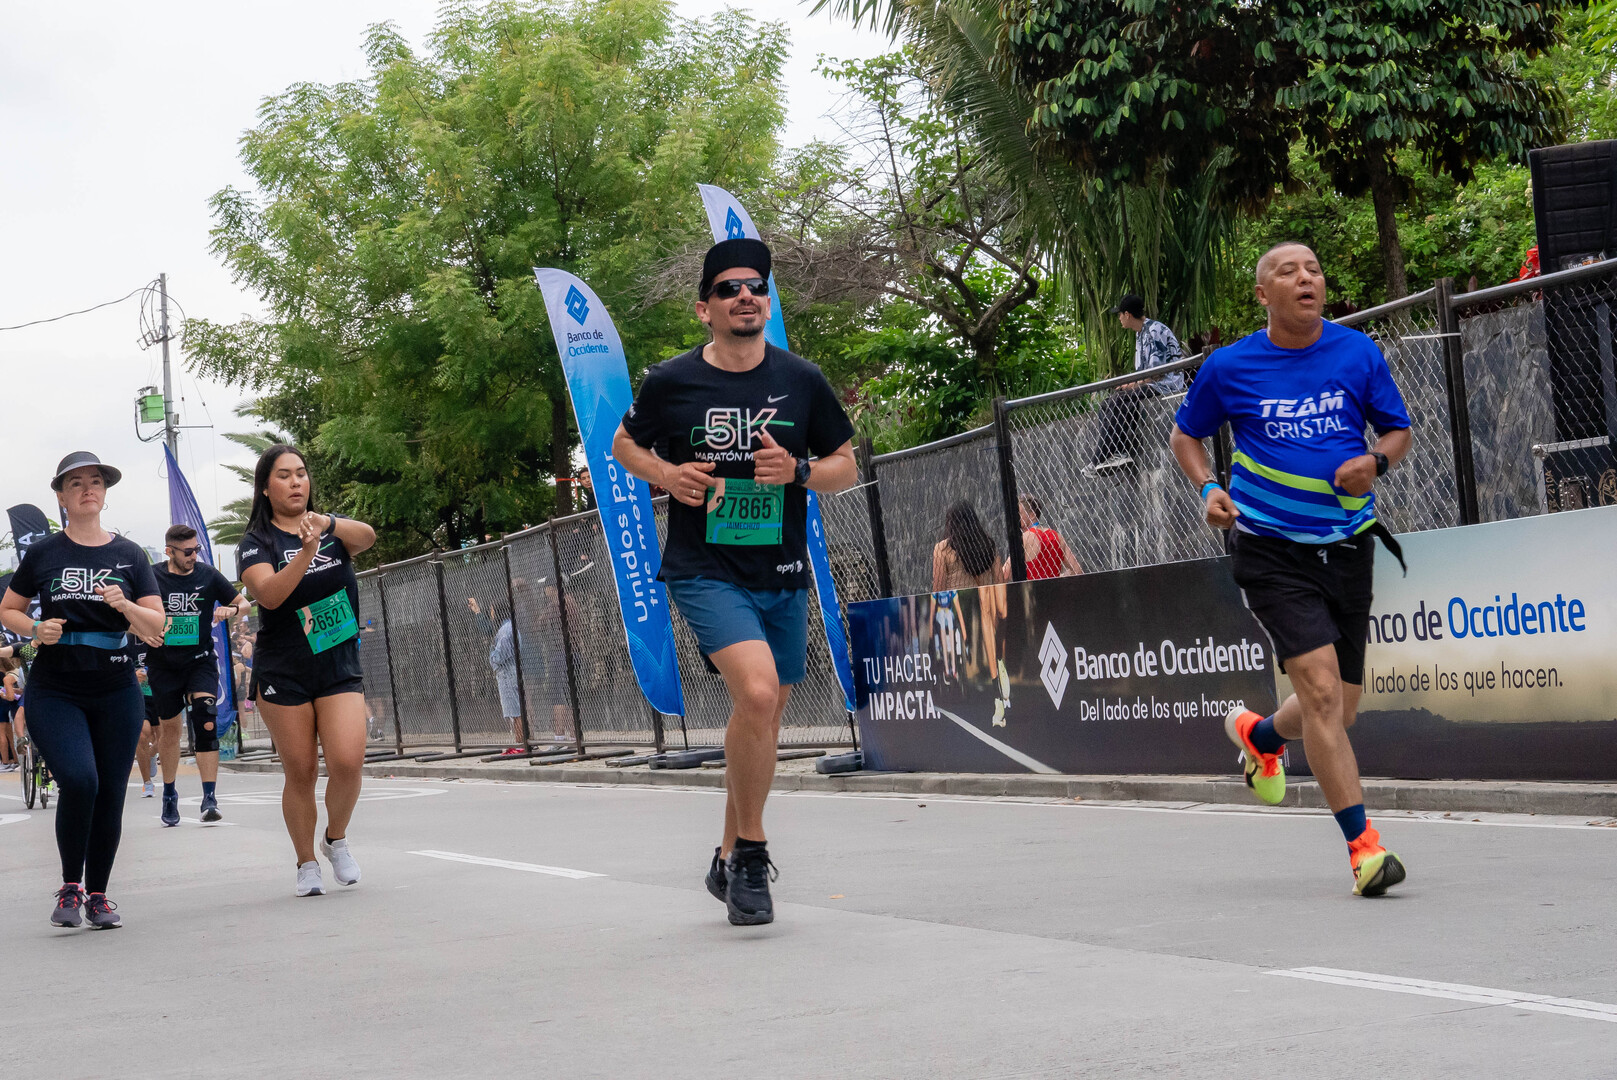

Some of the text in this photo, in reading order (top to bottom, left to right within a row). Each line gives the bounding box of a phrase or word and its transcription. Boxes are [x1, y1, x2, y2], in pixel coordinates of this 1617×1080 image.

[567, 329, 604, 343] Banco de
[568, 344, 609, 357] Occidente
[1259, 390, 1345, 418] TEAM
[705, 407, 777, 450] 5K
[1264, 415, 1349, 438] CRISTAL
[695, 450, 743, 462] MARATÓN
[625, 472, 647, 550] meta
[715, 496, 772, 519] 27865
[603, 450, 648, 623] Unidos por
[61, 567, 112, 594] 5K
[776, 562, 795, 575] epm
[51, 592, 87, 602] MARATÓN
[168, 592, 200, 611] 5K
[167, 624, 194, 635] 28530
[308, 604, 347, 634] 26521
[1367, 592, 1586, 644] nco de Occidente
[863, 653, 937, 685] TU HACER,
[1074, 636, 1265, 680] Banco de Occidente
[1371, 667, 1406, 694] lado
[1410, 664, 1430, 692] de
[1435, 664, 1458, 690] los
[1464, 670, 1496, 697] que
[1501, 661, 1563, 688] hacen.
[868, 690, 941, 721] IMPACTA.
[1080, 698, 1100, 721] Del
[1102, 697, 1130, 721] lado
[1132, 696, 1149, 719] de
[1151, 695, 1170, 719] los
[1173, 701, 1199, 724] que
